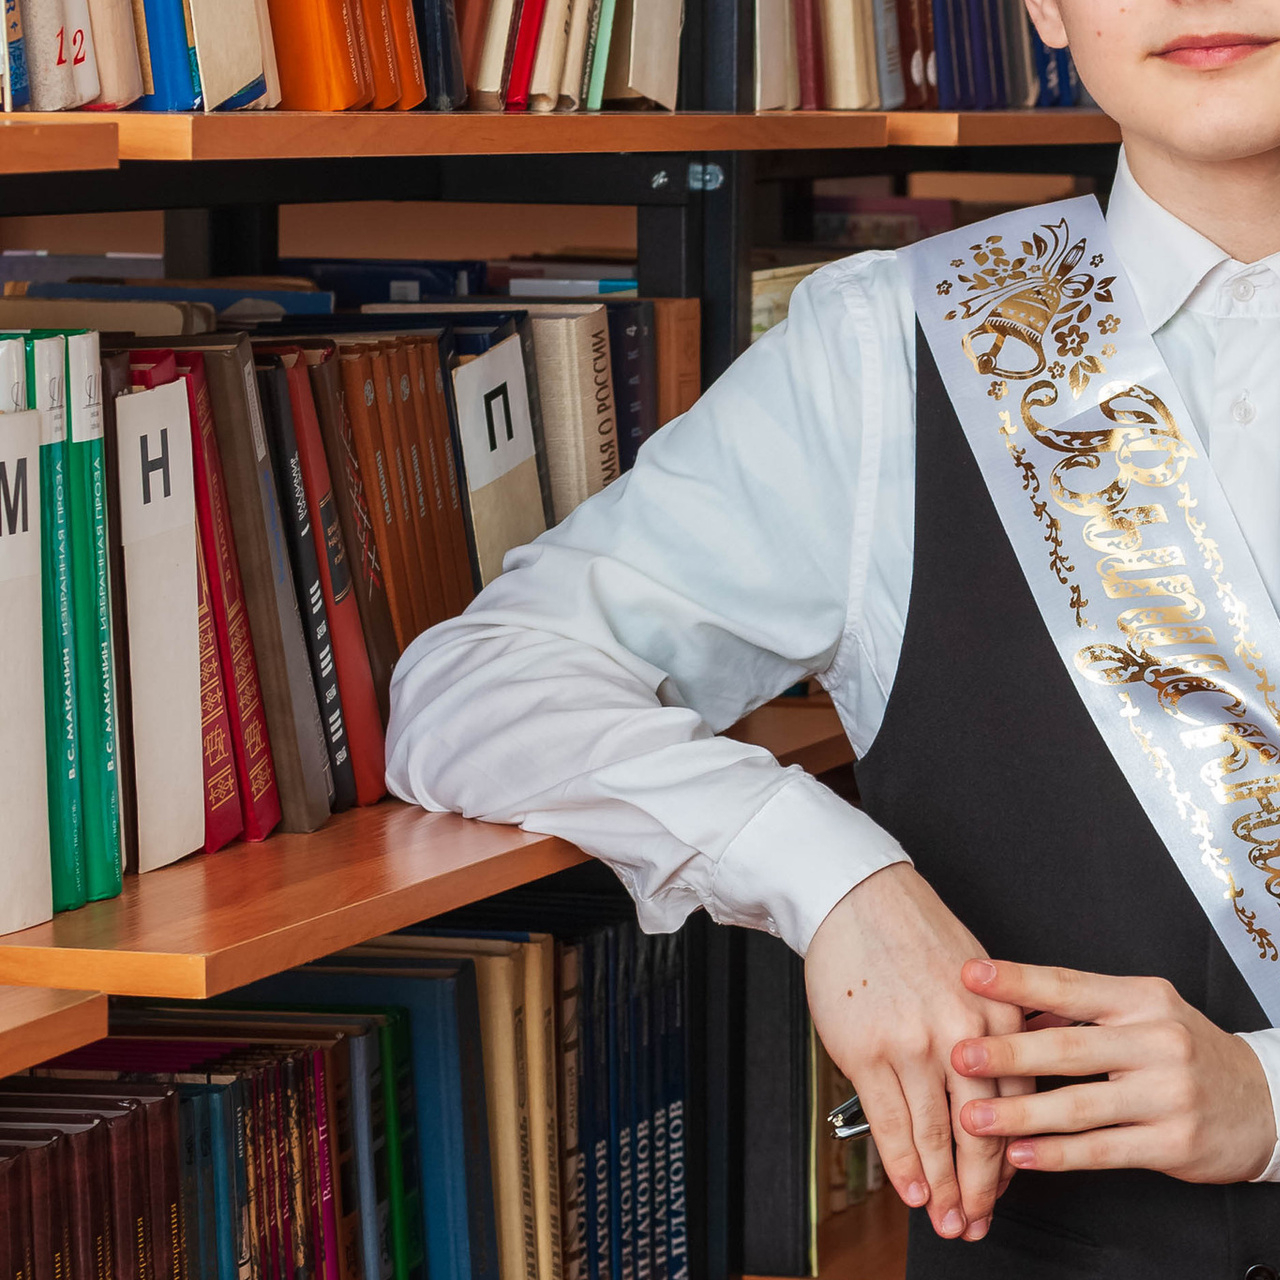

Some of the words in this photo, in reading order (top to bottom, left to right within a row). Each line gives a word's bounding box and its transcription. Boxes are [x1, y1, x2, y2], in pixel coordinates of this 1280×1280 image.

[56, 25, 67, 66] 1
[72, 28, 86, 66] 2
[590, 328, 612, 415] РОССИИ
[483, 381, 514, 453] П
[597, 422, 614, 437] О
[0, 457, 29, 536] М
[55, 460, 65, 524] ПРОЗА
[93, 457, 103, 519] ПРОЗА
[140, 427, 171, 505] Н
[56, 528, 73, 637] ИЗБРАННАЯ
[95, 524, 109, 631] ИЗБРАННАЯ
[62, 647, 75, 741] МАКАНИН
[101, 641, 114, 734] МАКАНИН
[67, 742, 76, 761] С.
[69, 764, 76, 780] В.
[106, 735, 115, 756] С.
[107, 756, 115, 772] В.
[515, 1115, 533, 1212] ПИКУЛЬ
